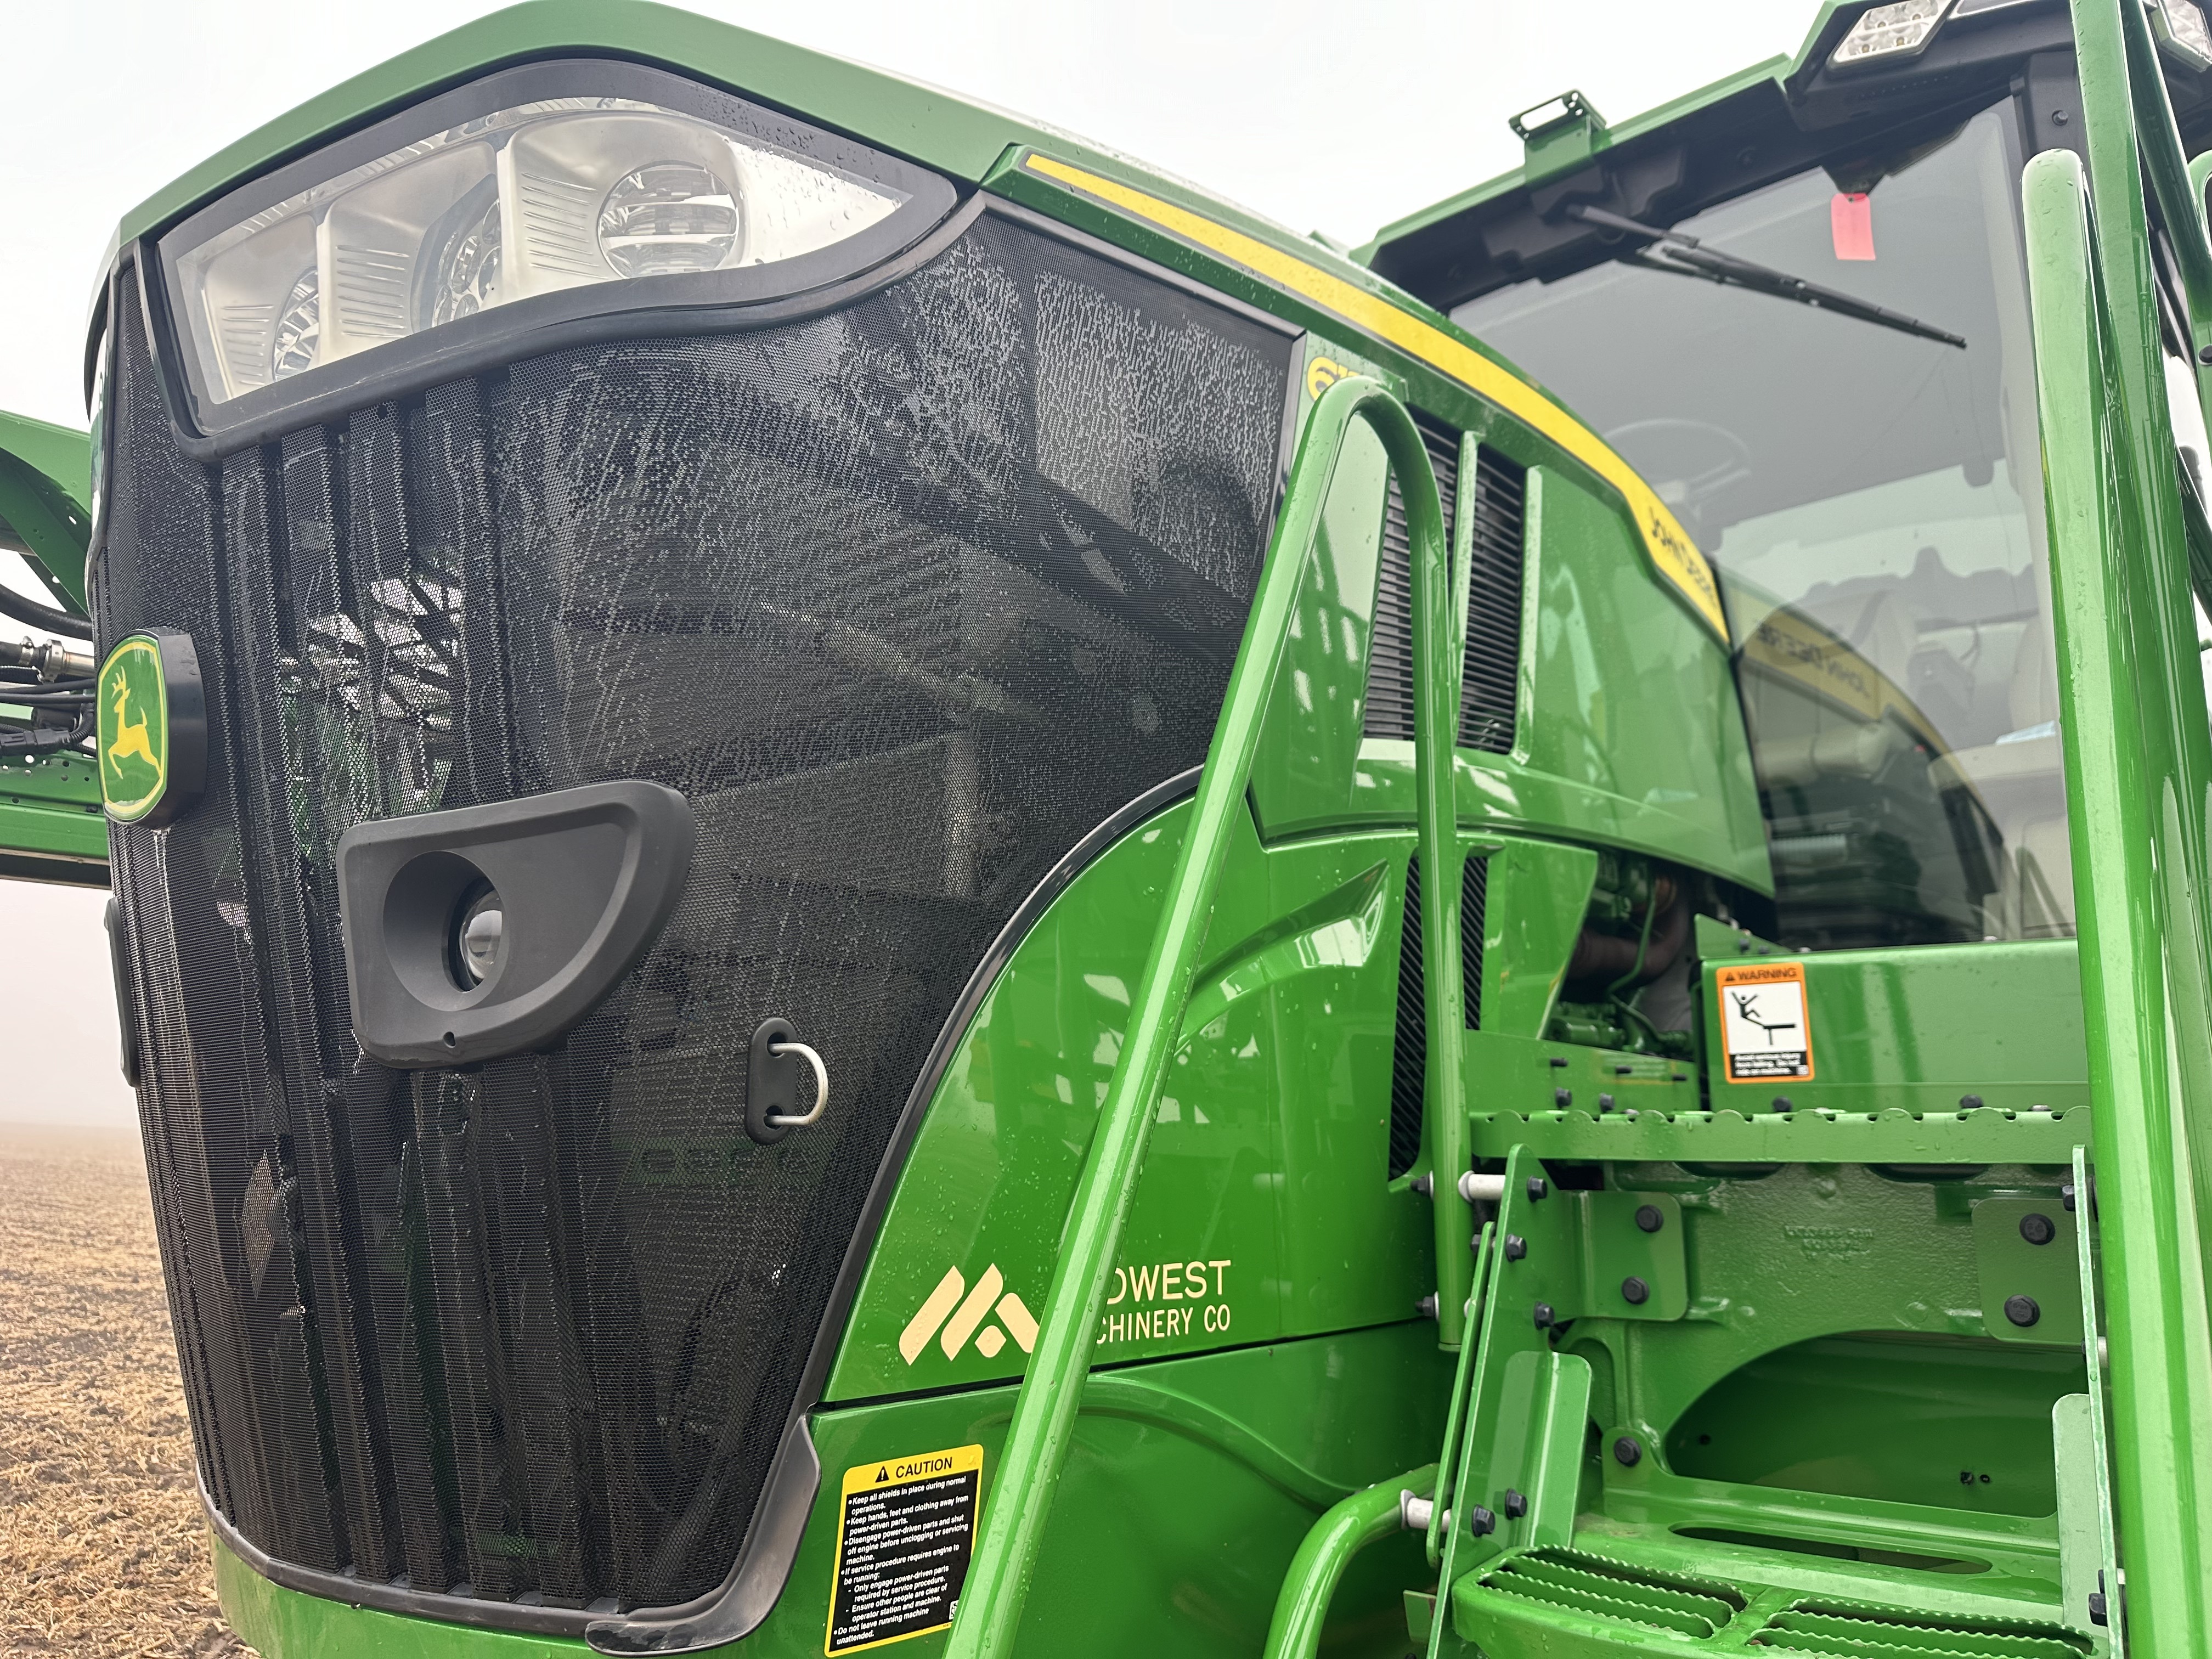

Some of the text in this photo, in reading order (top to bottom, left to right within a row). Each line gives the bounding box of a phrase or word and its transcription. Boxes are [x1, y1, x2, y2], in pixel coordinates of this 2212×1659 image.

[1737, 967, 1797, 980] WARNING
[1107, 1260, 1231, 1305] DWEST
[1096, 1304, 1231, 1344] HINERY CO
[896, 1457, 952, 1478] CAUTION
[853, 1496, 868, 1505] Keep
[878, 1489, 900, 1499] shields
[909, 1486, 924, 1495] place
[926, 1481, 945, 1490] during
[946, 1475, 966, 1486] normal
[850, 1495, 969, 1525] Keep hands, feet and clothing away from
[848, 1547, 856, 1555] off
[857, 1543, 879, 1553] engine
[880, 1538, 900, 1549] before
[901, 1531, 934, 1544] unclogging
[942, 1523, 968, 1535] servicing
[849, 1521, 889, 1537] power-driven
[849, 1514, 964, 1545] Disengage power-driven parts and shut
[845, 1567, 850, 1576] If
[851, 1564, 874, 1574] service
[874, 1556, 906, 1571] procedure
[907, 1550, 932, 1562] requires
[933, 1546, 952, 1556] engine
[844, 1577, 852, 1585] be
[854, 1565, 949, 1593] Only engage power-driven parts
[854, 1589, 881, 1602] required
[882, 1589, 890, 1597] by
[891, 1583, 913, 1594] service
[851, 1602, 874, 1613] Ensure
[875, 1598, 892, 1607] other
[893, 1592, 913, 1605] people
[926, 1586, 940, 1595] clear
[941, 1583, 948, 1592] of
[851, 1610, 879, 1623] operator
[880, 1605, 901, 1616] station
[902, 1601, 914, 1611] and
[848, 1624, 860, 1633] not
[861, 1621, 877, 1630] leave
[878, 1614, 903, 1626] running
[904, 1607, 929, 1620] machine
